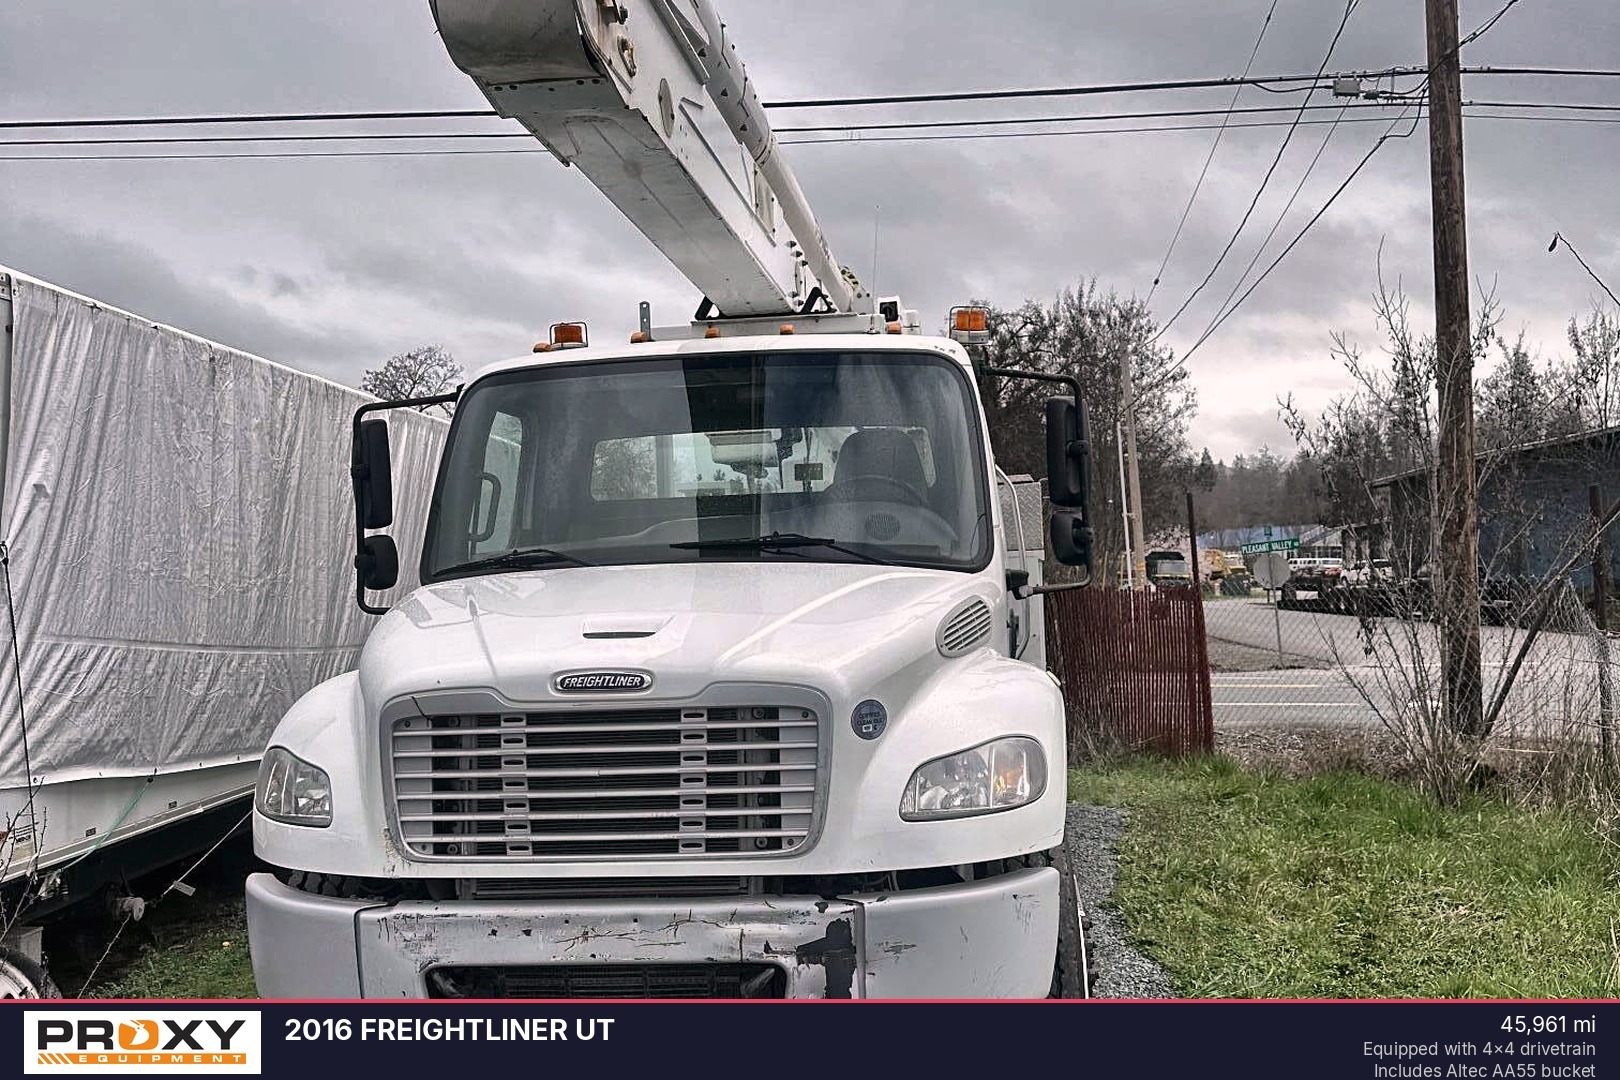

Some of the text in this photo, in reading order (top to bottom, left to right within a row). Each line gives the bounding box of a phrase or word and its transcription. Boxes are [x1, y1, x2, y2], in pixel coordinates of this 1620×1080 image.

[1242, 543, 1269, 554] PLEASANT
[1271, 540, 1292, 550] VALLEY
[563, 676, 641, 687] FREIGHTLINER
